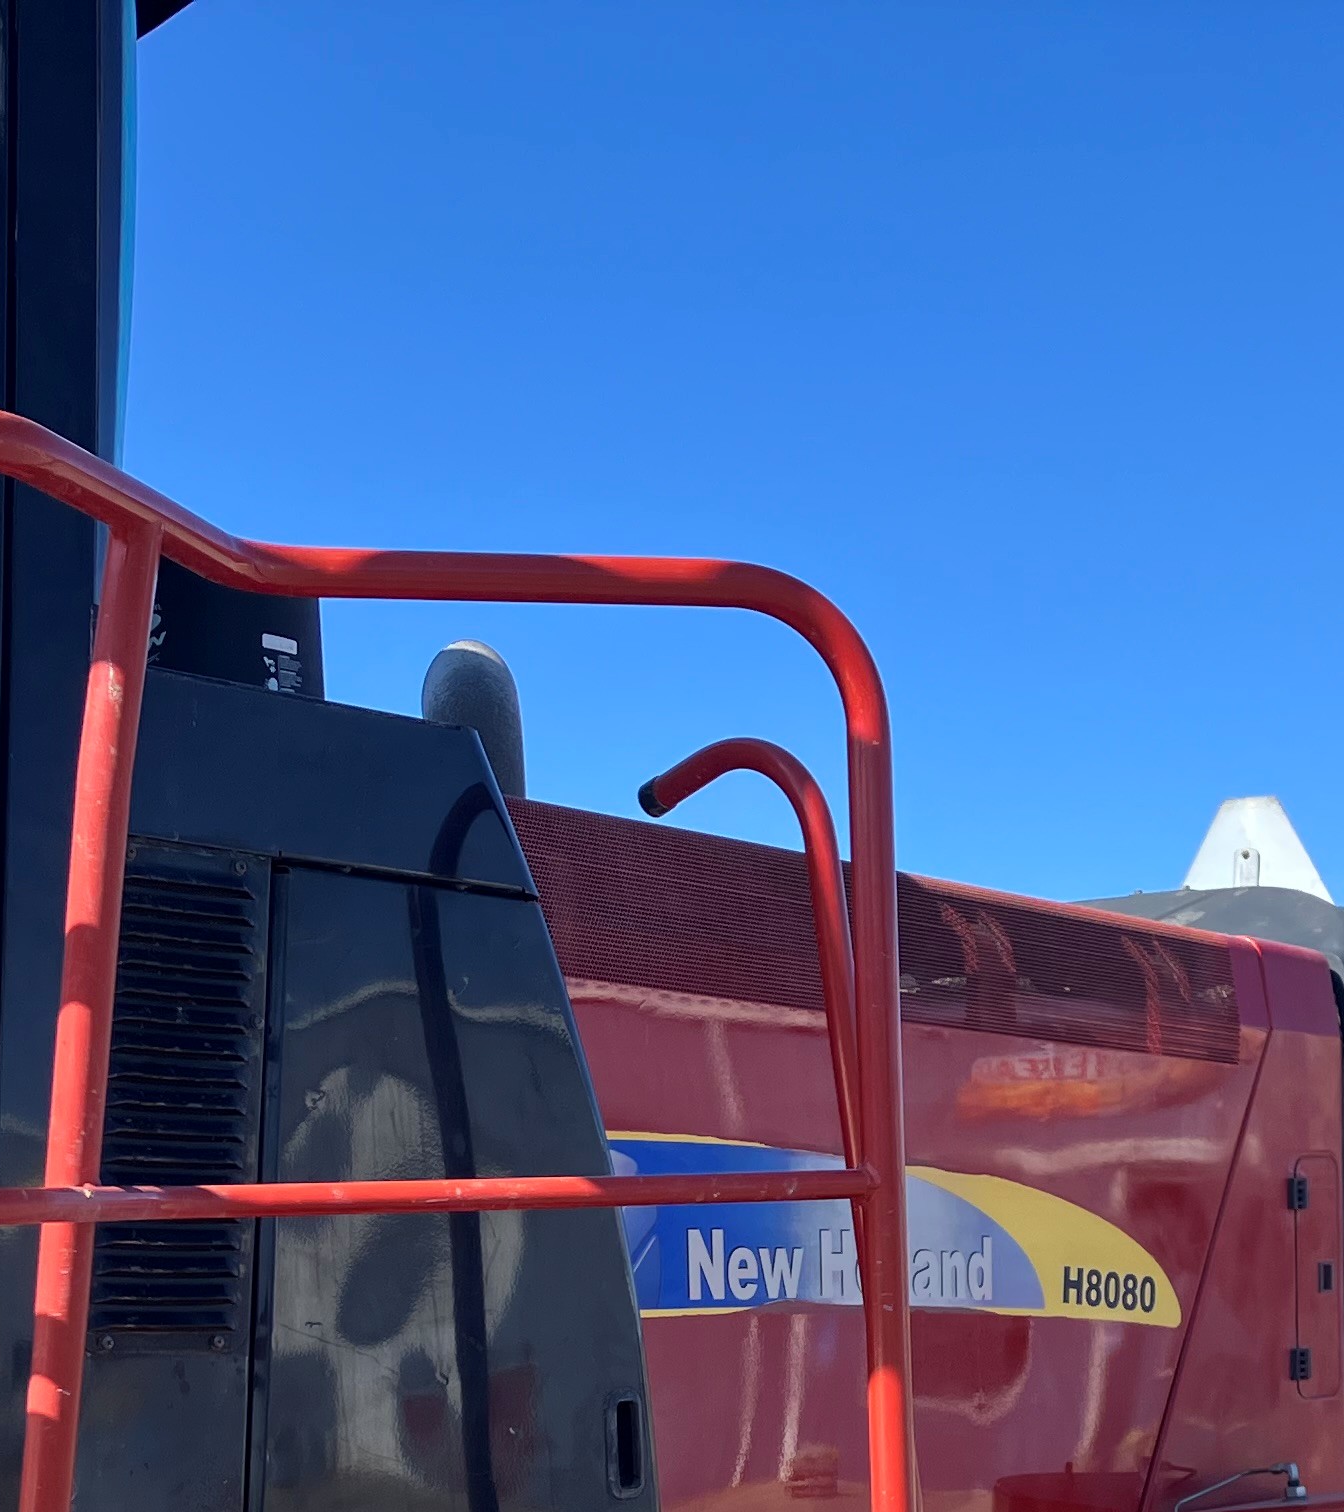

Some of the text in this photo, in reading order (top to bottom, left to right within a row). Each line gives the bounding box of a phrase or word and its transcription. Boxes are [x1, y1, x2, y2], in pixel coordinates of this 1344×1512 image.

[687, 1227, 993, 1301] New Hand
[1062, 1266, 1157, 1313] H8080
